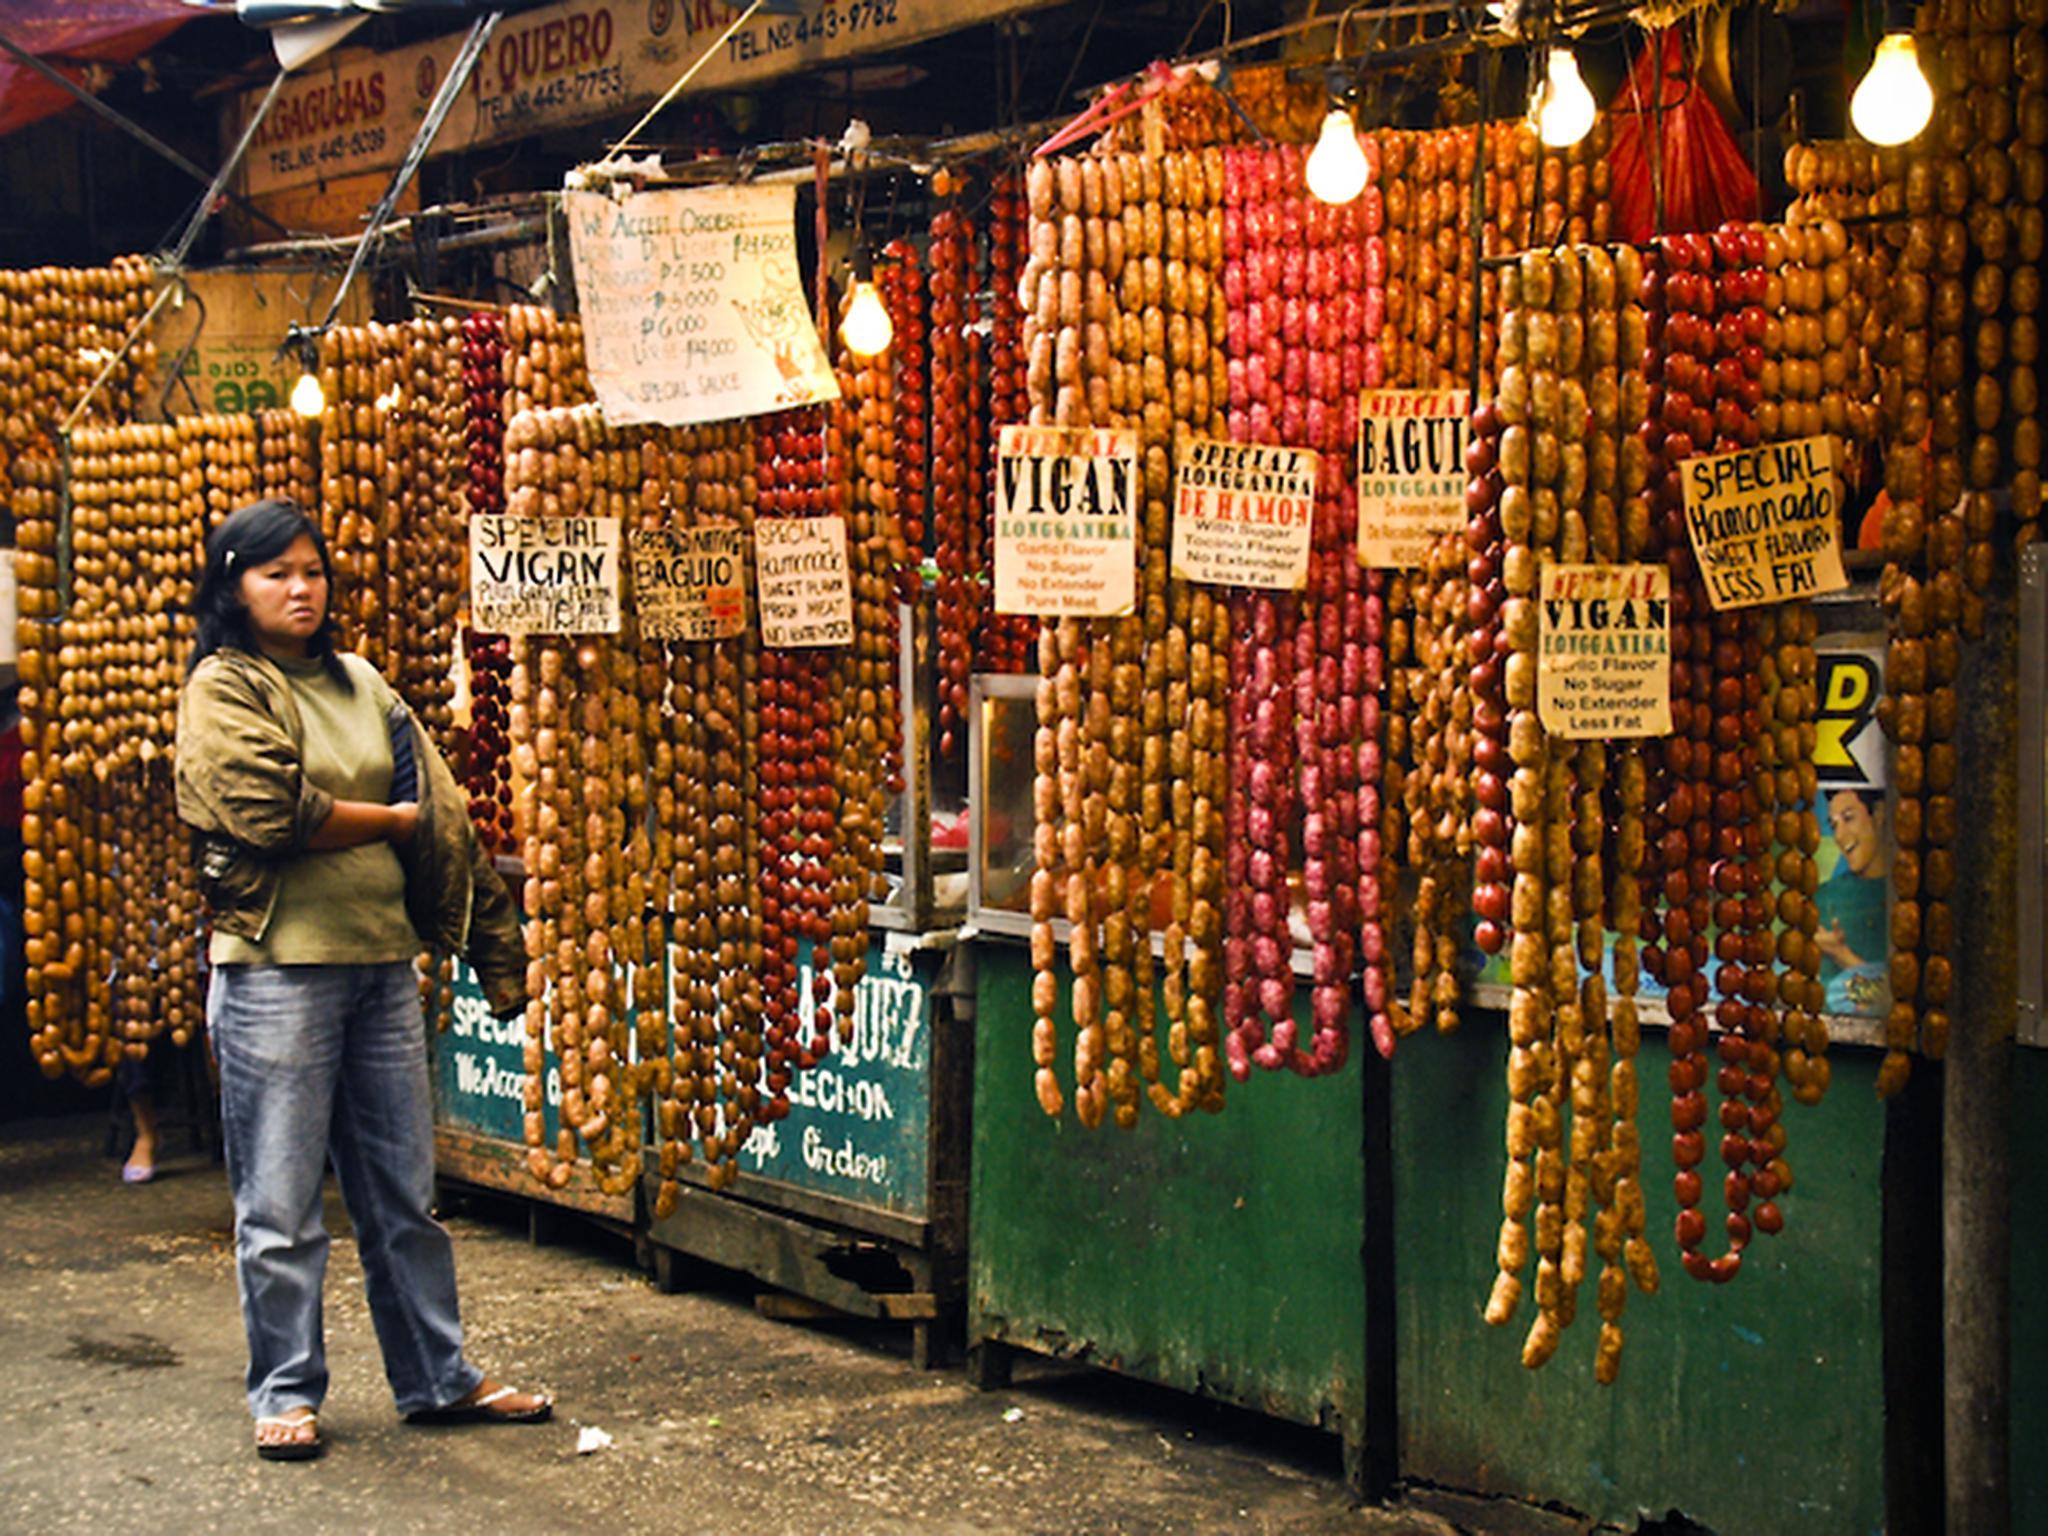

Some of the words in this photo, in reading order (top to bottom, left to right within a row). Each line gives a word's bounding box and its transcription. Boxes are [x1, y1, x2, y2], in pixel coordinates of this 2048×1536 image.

[498, 8, 613, 92] QUERO
[1191, 442, 1300, 475] SPECIAL
[1692, 443, 1831, 501] SPECIAL
[1001, 455, 1132, 516] VIGAN
[1181, 466, 1312, 497] LONGGANISA
[1217, 492, 1311, 529] HAMON
[1688, 482, 1833, 548] Hamonado
[478, 516, 609, 549] SPECIAL
[757, 520, 831, 546] SPECIAL
[1000, 519, 1132, 540] LONGGANISA
[478, 549, 606, 588] VIGAN
[635, 556, 733, 591] BAGUIO
[1026, 559, 1047, 573] No
[1050, 559, 1094, 577] Sugar
[1186, 549, 1211, 563] No
[1215, 552, 1296, 570] Extender
[1018, 577, 1037, 590] No
[1040, 577, 1106, 591] Extender
[1201, 567, 1243, 582] Less
[1249, 571, 1277, 584] Fat
[1711, 567, 1766, 603] LESS
[1771, 556, 1818, 596] FAT
[1025, 594, 1058, 608] Pure
[1062, 595, 1099, 609] Meat
[1545, 598, 1667, 631] VIGAN
[1544, 633, 1668, 655] LONGGANISA
[1602, 657, 1658, 671] Flavor
[1564, 676, 1588, 690] No
[1592, 676, 1644, 694] Sugar
[1553, 697, 1575, 710] No
[1580, 696, 1658, 711] Extender
[1570, 715, 1608, 730] Less
[1614, 715, 1642, 729] Fat
